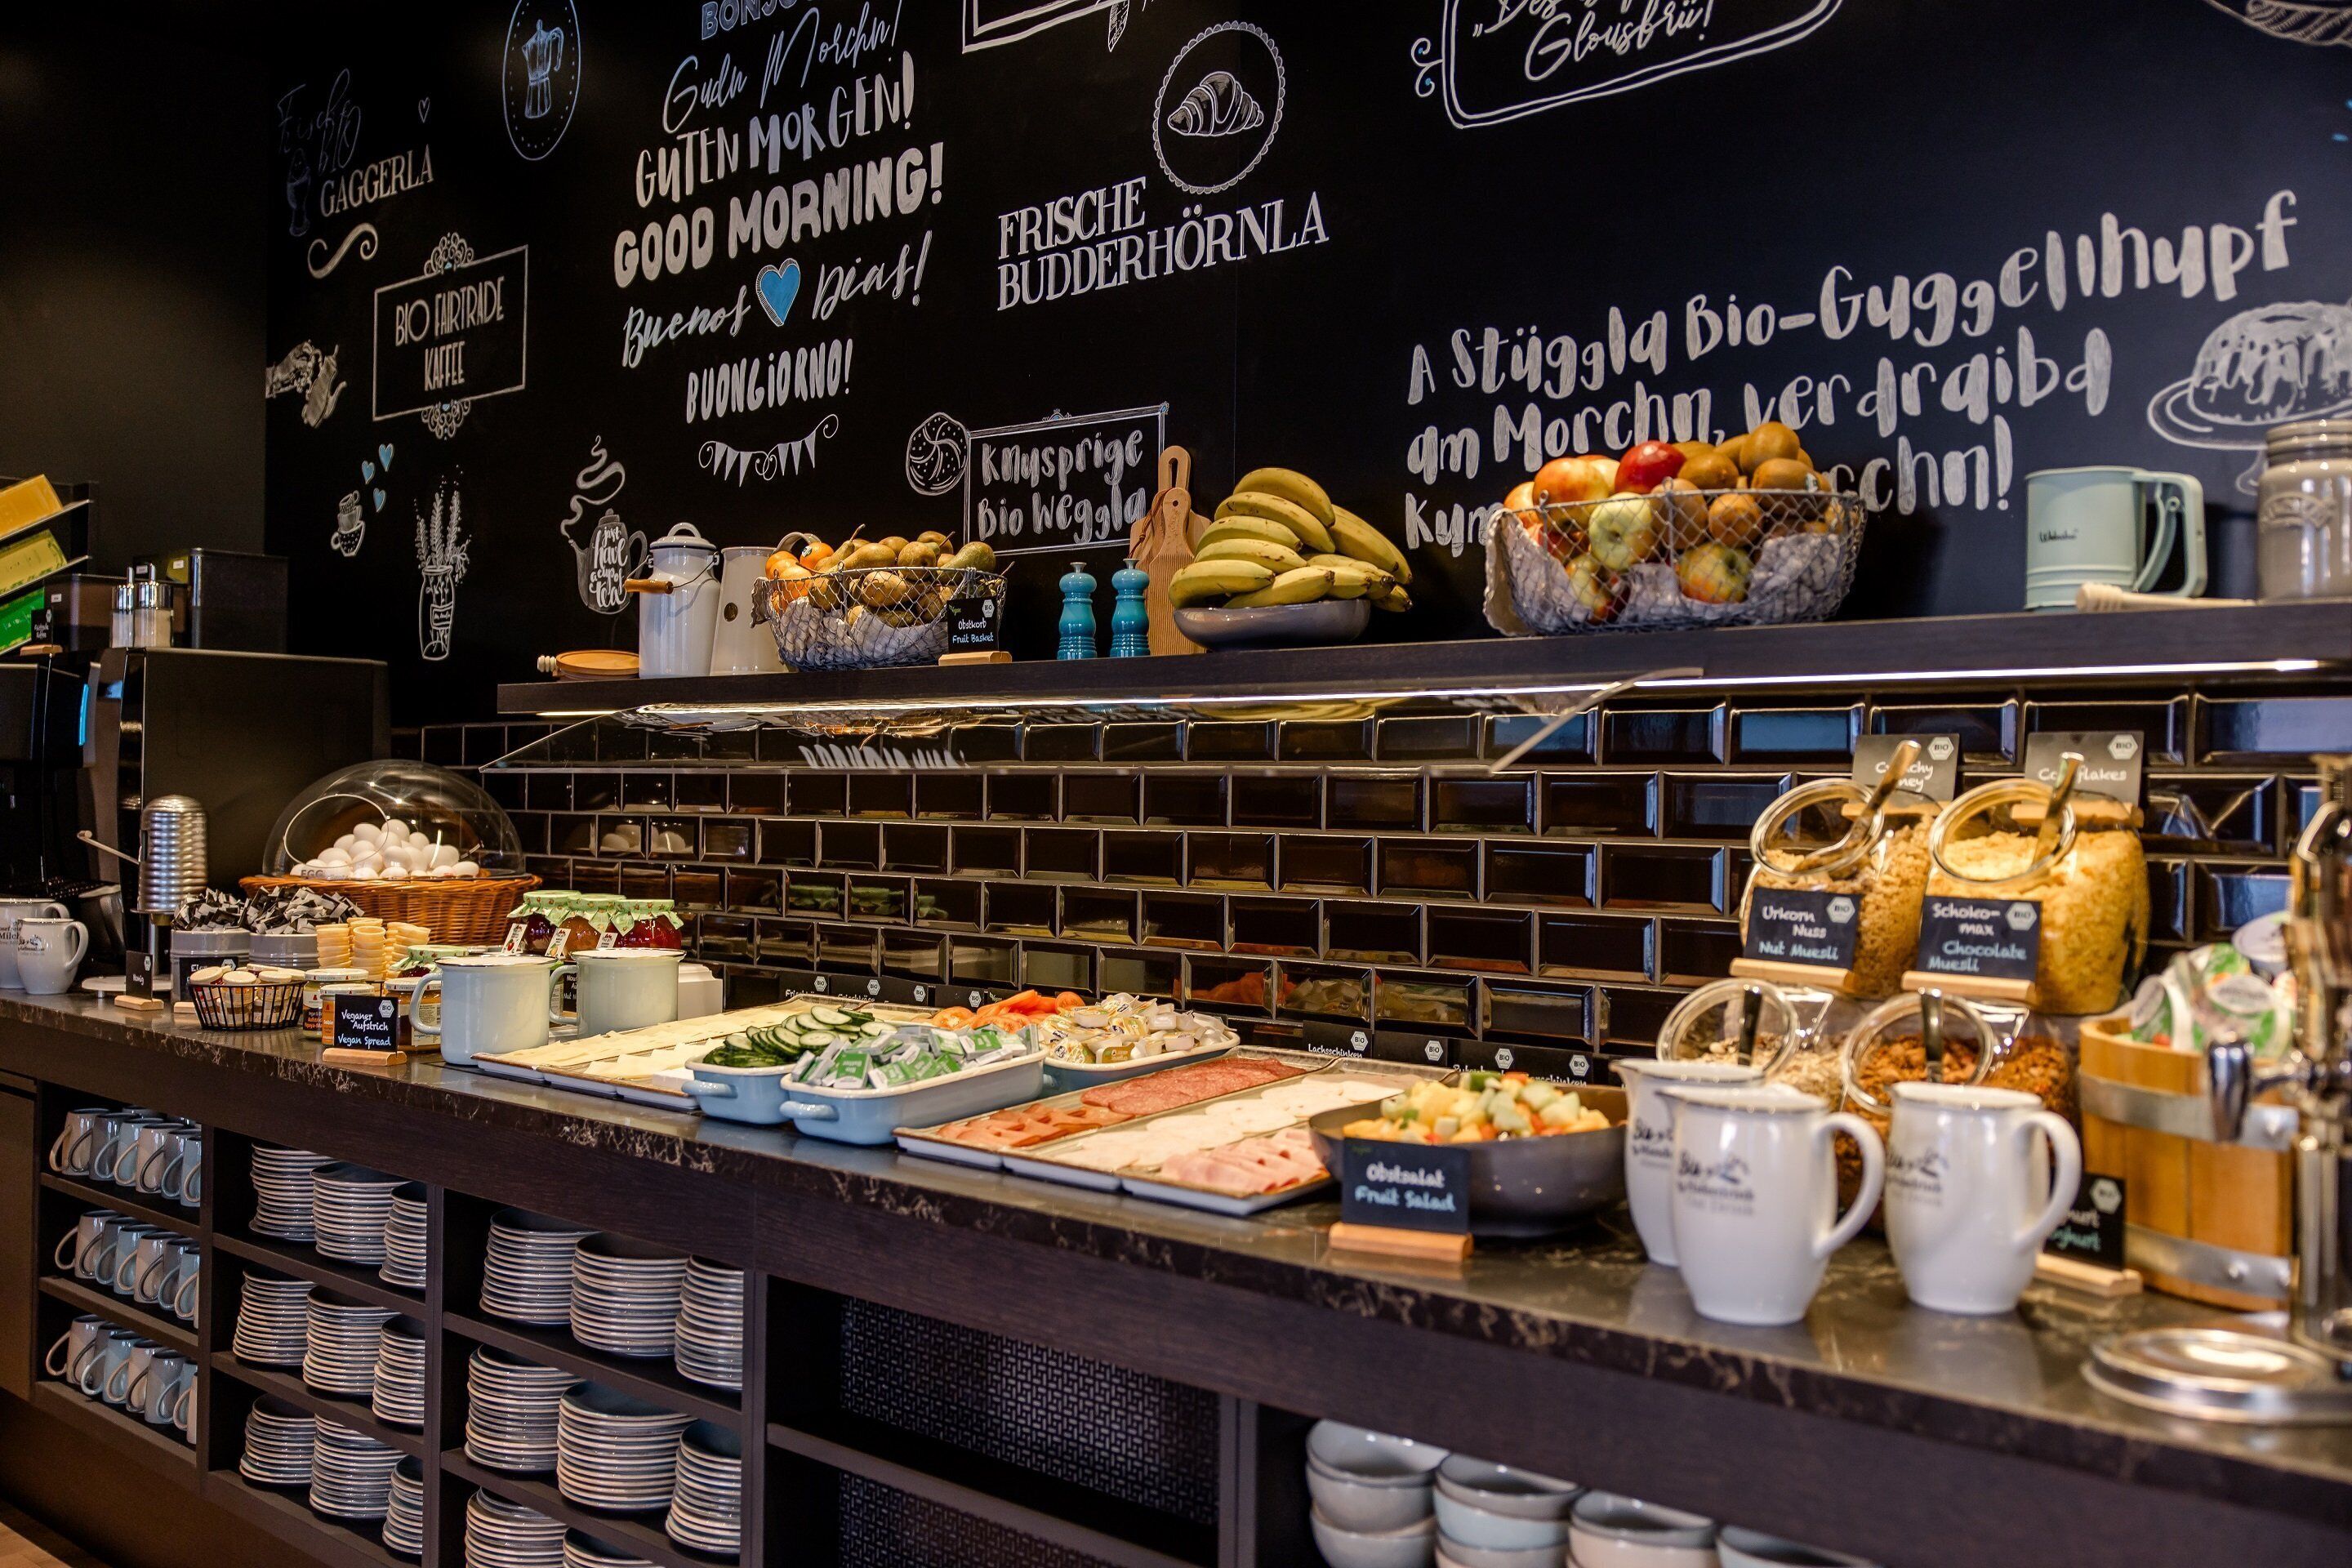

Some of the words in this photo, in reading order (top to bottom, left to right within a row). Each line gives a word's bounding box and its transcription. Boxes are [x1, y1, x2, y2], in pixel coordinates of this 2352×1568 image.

[320, 144, 434, 218] GAGGERLA
[636, 127, 739, 207] GUTEN
[614, 206, 715, 287] GOOD
[728, 141, 944, 259] MORNING!
[997, 176, 1147, 260] FRISCHE
[996, 191, 1330, 311] BUDDERHÖRNLA
[394, 299, 430, 346] BIO
[434, 276, 505, 339] FAIRTRADE
[621, 283, 751, 368] Buenos
[424, 341, 466, 391] KAFFEE
[1407, 344, 1436, 405] A
[1451, 305, 1667, 399] Stüggla
[982, 429, 1143, 492] Knusprige
[1407, 425, 1480, 485] am
[601, 526, 621, 547] just
[978, 497, 1024, 541] Bio
[594, 530, 628, 569] have
[589, 580, 627, 608] tea
[952, 634, 969, 644] Fruit
[971, 632, 994, 644] Basket
[958, 617, 987, 630] Obstkorb
[1762, 905, 1815, 923] Urkorn
[1792, 924, 1827, 939] Nuss
[1758, 940, 1786, 956] Nut
[1941, 939, 2027, 960] Chocolate
[341, 1009, 373, 1022] Veganer
[352, 1021, 389, 1032] Aufstrich
[338, 1033, 362, 1047] Vegan
[364, 1036, 392, 1049] Spread
[1307, 1043, 1363, 1059] Lachsschinken
